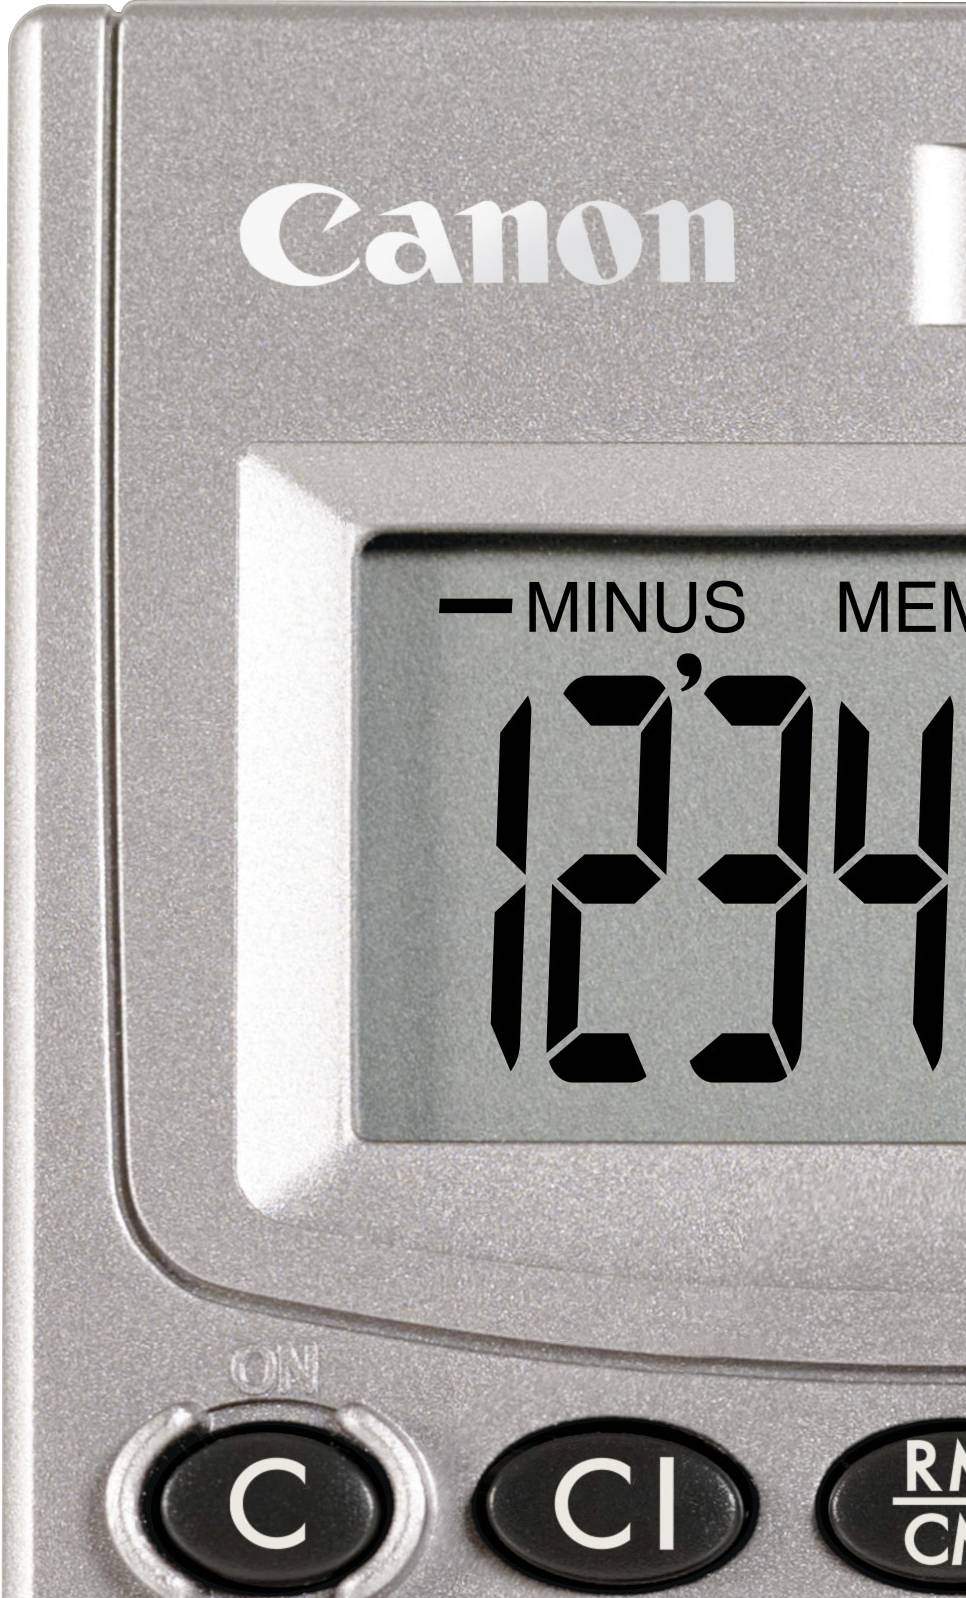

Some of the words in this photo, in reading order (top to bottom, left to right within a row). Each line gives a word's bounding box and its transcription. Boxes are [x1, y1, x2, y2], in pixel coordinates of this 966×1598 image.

[239, 183, 735, 286] Canon
[230, 1342, 318, 1396] ON
[230, 1458, 305, 1549] C
[555, 1457, 674, 1550] CI
